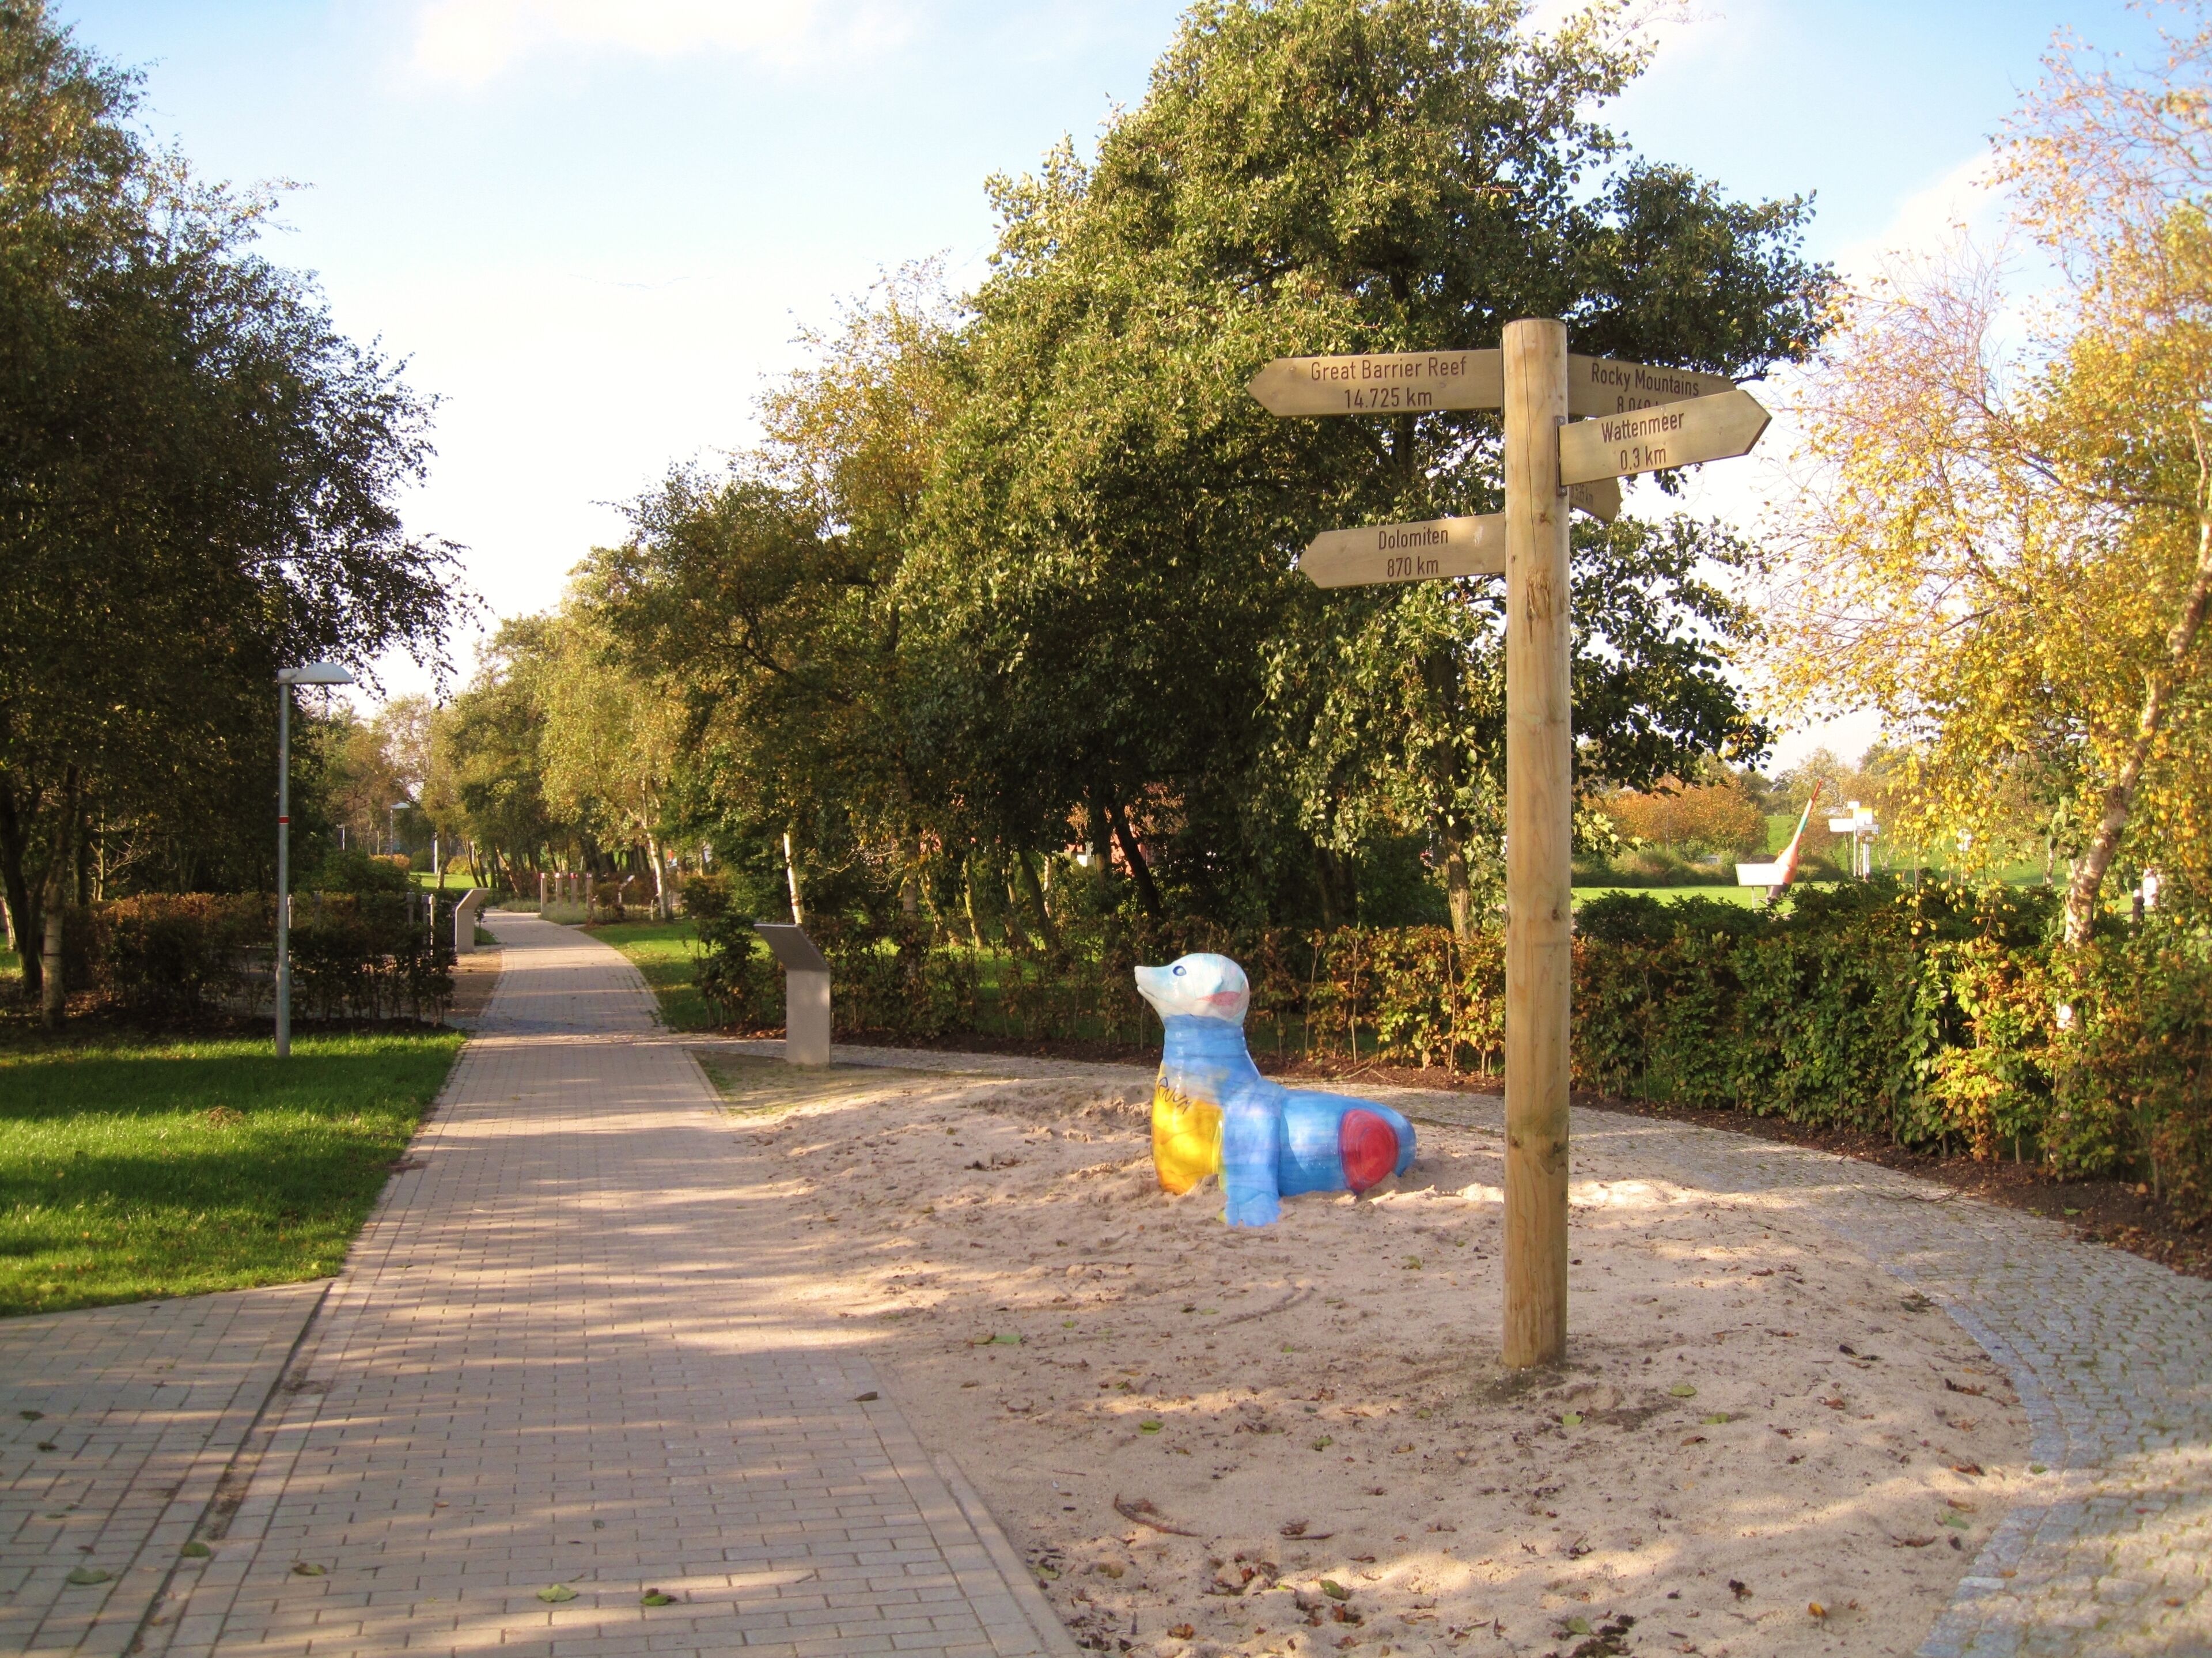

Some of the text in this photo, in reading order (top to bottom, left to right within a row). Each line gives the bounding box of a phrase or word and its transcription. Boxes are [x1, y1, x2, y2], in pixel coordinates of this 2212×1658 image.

[1311, 356, 1467, 381] Great Barrier Reef
[1592, 363, 1699, 397] Rocky Mountains
[1344, 384, 1432, 408] 14.725 km
[1601, 412, 1684, 443] Wattenmeer
[1620, 446, 1666, 471] 0.3 km
[1378, 527, 1448, 550] Dolomiten
[1387, 555, 1438, 577] 870 km
